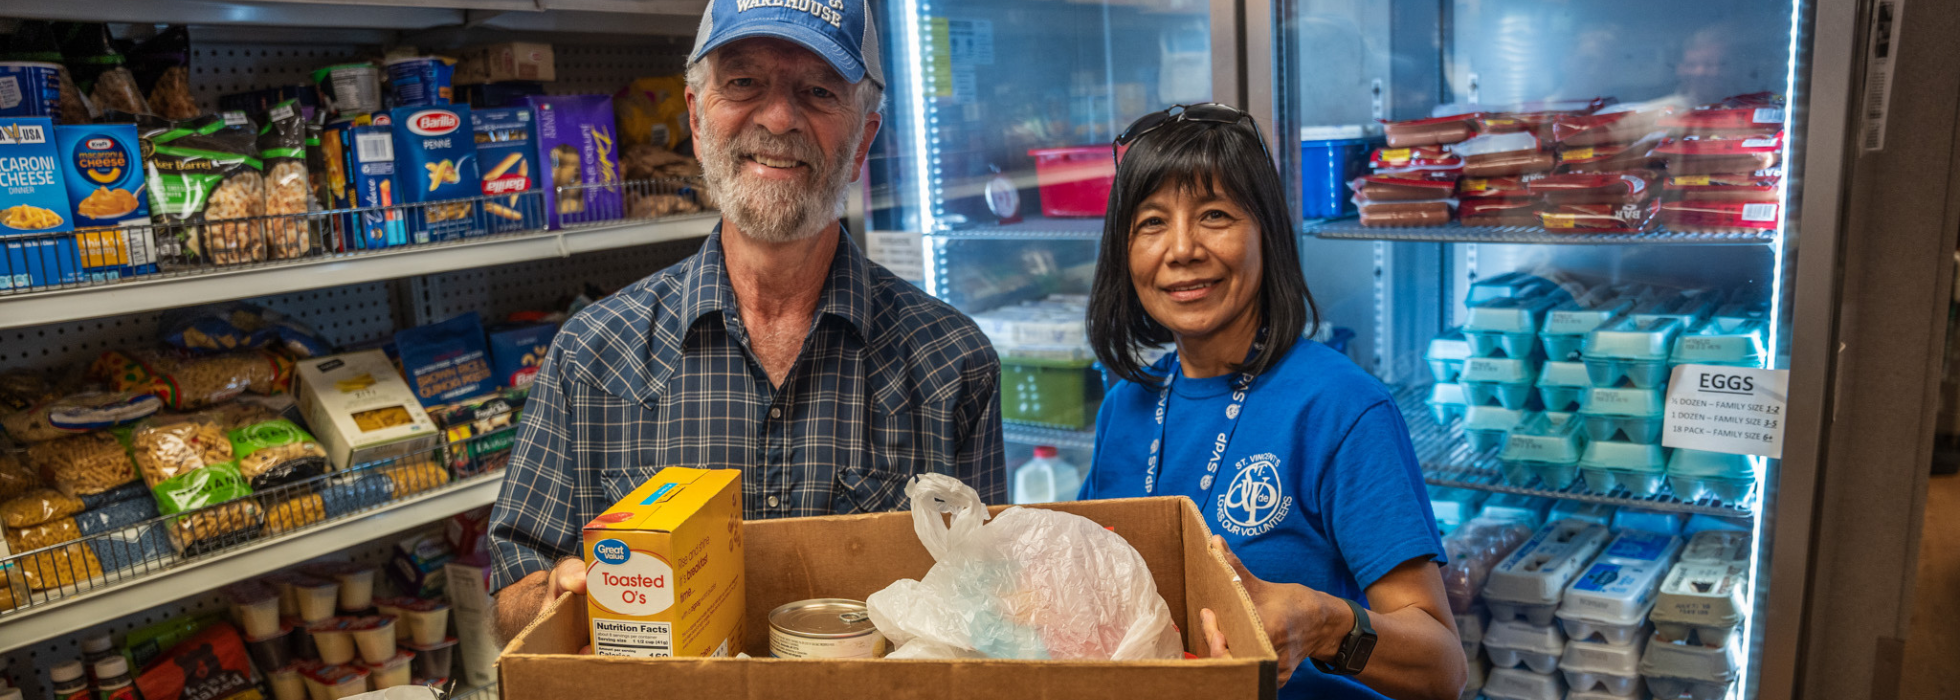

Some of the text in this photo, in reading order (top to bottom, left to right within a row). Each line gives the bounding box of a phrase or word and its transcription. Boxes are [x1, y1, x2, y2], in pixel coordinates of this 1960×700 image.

[420, 115, 456, 129] Barilla
[22, 128, 42, 141] USA
[91, 141, 108, 149] Kraft
[423, 138, 452, 150] PENNE
[175, 159, 212, 171] Barrel
[0, 170, 55, 187] CHEESE
[8, 186, 35, 195] DINNER
[487, 179, 525, 193] Barilla
[1699, 372, 1754, 392] EGGS
[1154, 388, 1168, 425] SVdP
[1680, 397, 1707, 408] DOZEN
[1715, 401, 1745, 411] FAMILY
[1747, 404, 1764, 412] SIZE
[1765, 405, 1780, 414] 1-2
[1678, 411, 1706, 422] DOZEN
[1713, 414, 1743, 425] FAMILY
[1745, 417, 1762, 426] SIZE
[1763, 419, 1778, 428] 3-5
[1673, 425, 1682, 433] 18
[1684, 426, 1705, 435] PACK
[1713, 429, 1743, 439] FAMILY
[1744, 431, 1760, 440] SIZE
[1206, 432, 1227, 474] SVdP
[1235, 457, 1248, 470] ST.
[1144, 455, 1157, 494] SVdP
[1221, 519, 1241, 536] OUR
[1240, 495, 1293, 537] VOLUNTEERS
[597, 544, 625, 555] Great
[604, 552, 625, 560] Value
[602, 571, 665, 589] Toasted
[622, 590, 647, 605] O's
[596, 622, 668, 634] Nutrition Facts
